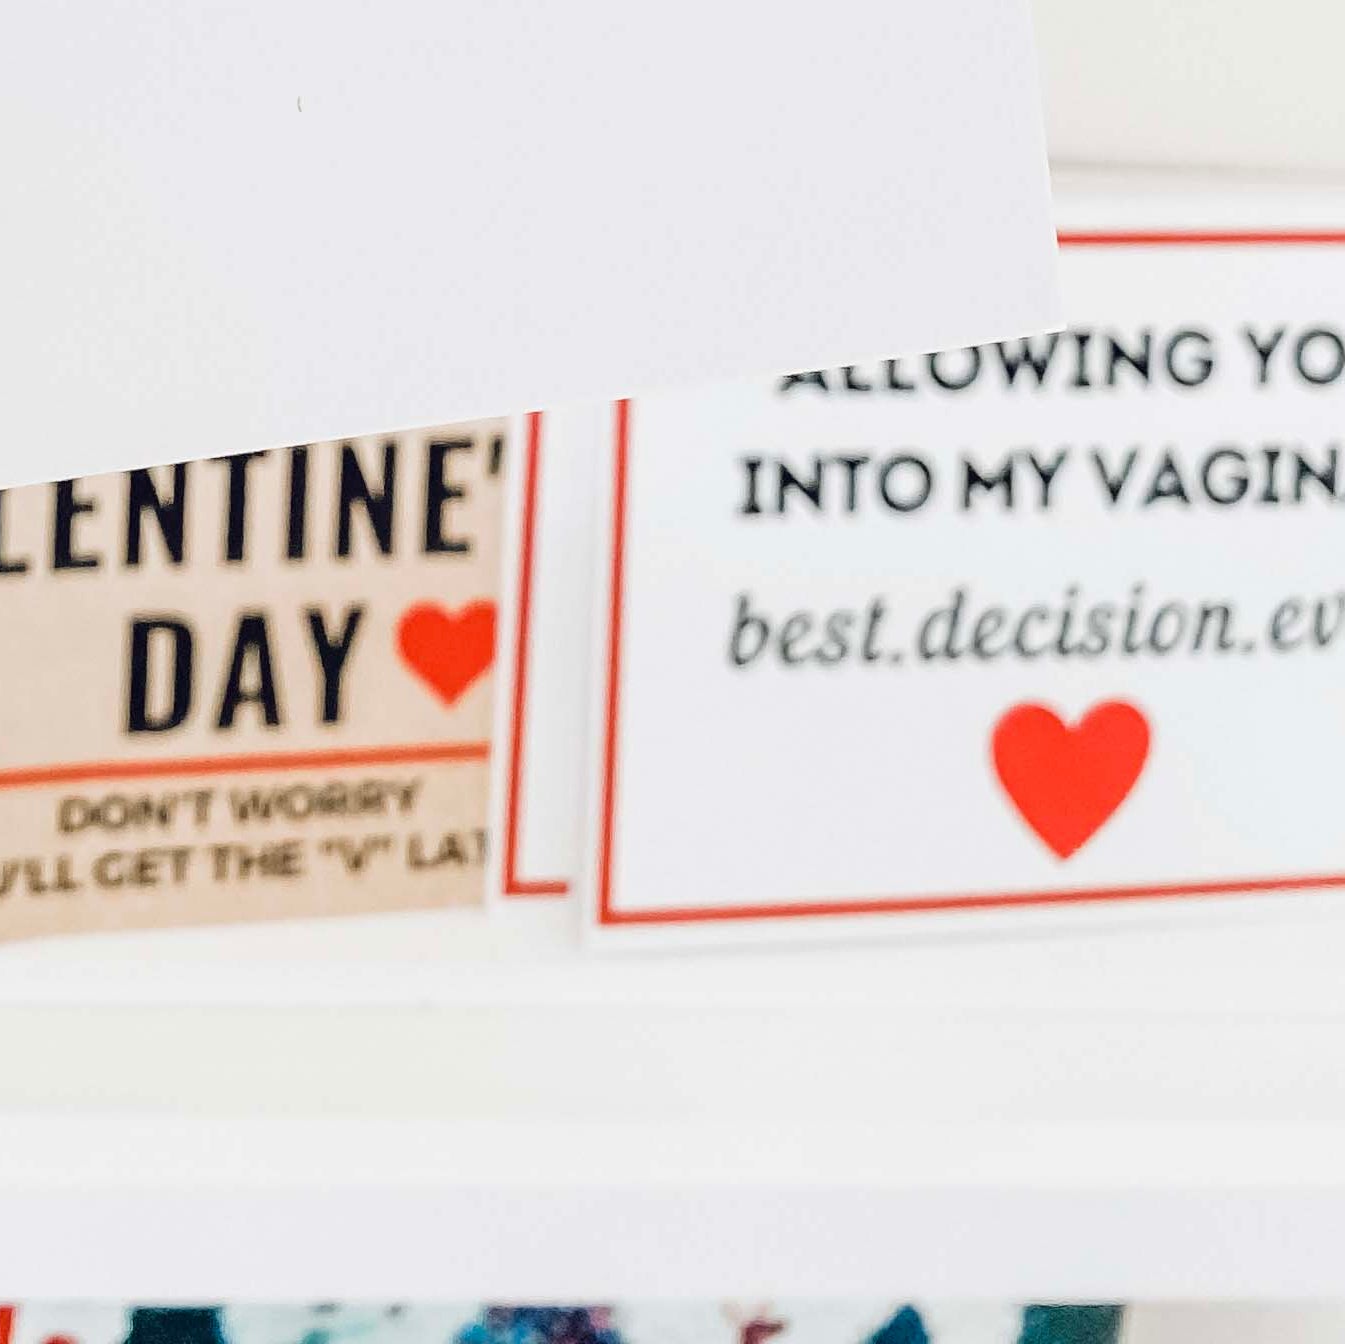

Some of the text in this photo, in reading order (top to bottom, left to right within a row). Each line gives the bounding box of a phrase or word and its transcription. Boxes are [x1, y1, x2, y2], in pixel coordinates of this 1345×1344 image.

[740, 446, 1345, 516] INTO MY VAGIN
[122, 602, 366, 738] DAY
[56, 776, 423, 838] DON'T WORRY
[90, 844, 197, 892] GET
[206, 837, 308, 884] THE
